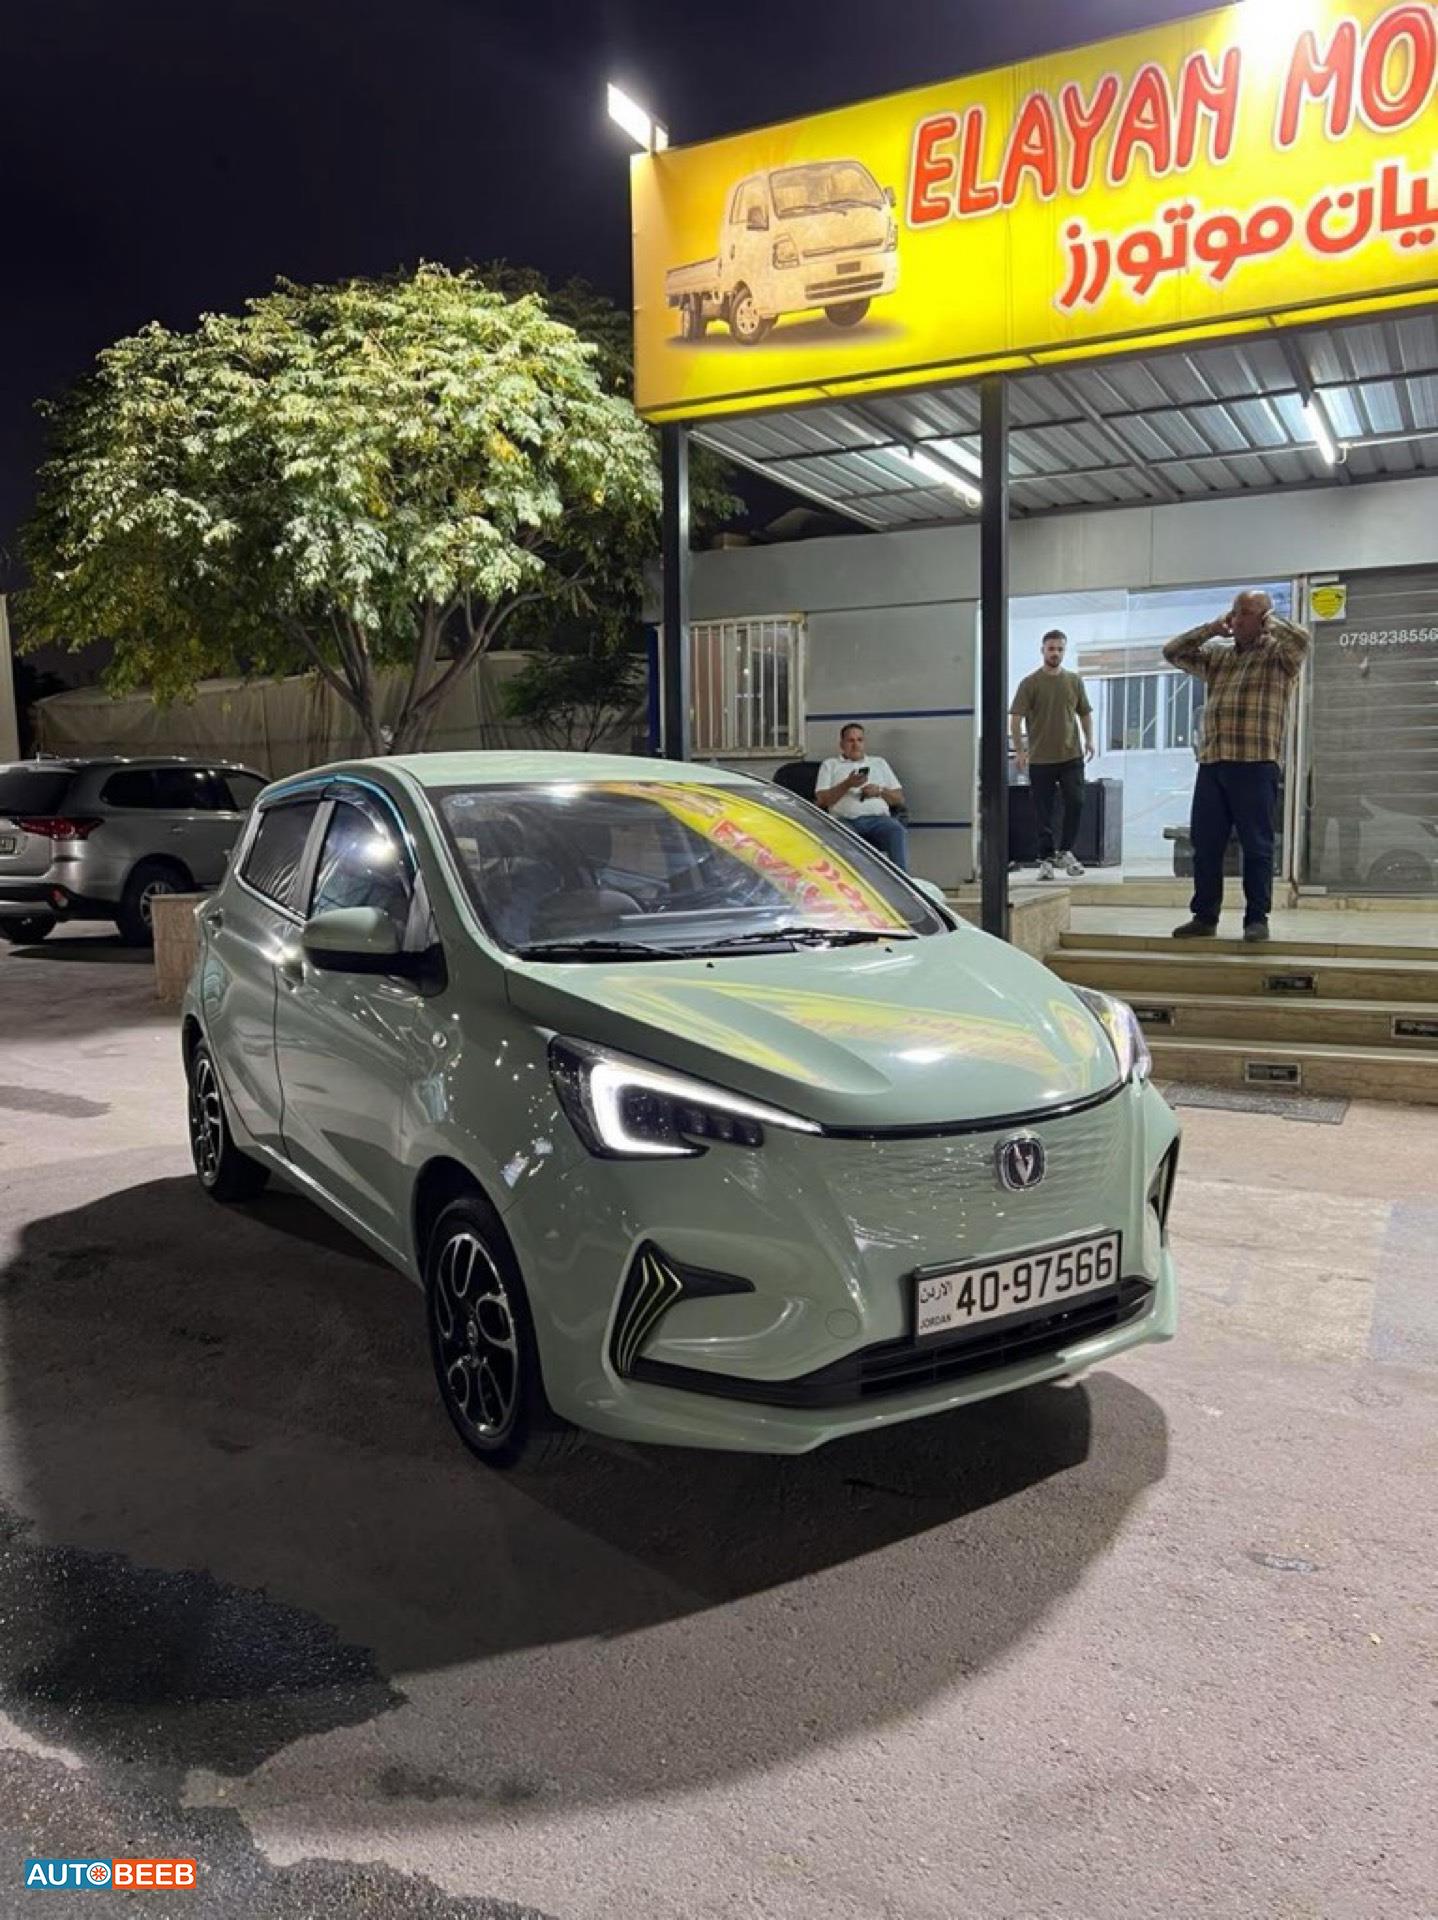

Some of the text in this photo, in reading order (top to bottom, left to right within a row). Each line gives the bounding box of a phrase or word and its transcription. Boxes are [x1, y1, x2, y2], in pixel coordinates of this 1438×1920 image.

[908, 46, 1243, 226] ELAYAN
[1060, 165, 1438, 308] يان موتورز
[919, 1313, 952, 1330] JORDAN
